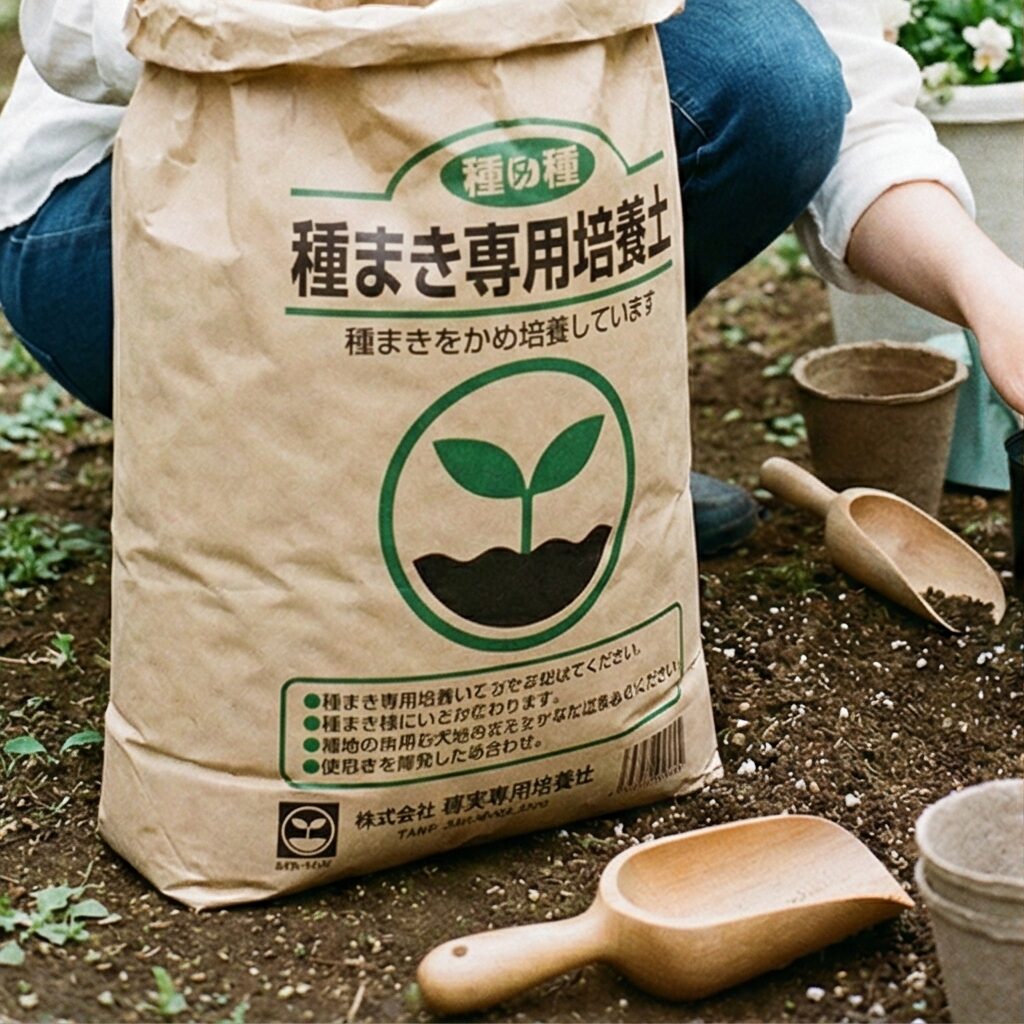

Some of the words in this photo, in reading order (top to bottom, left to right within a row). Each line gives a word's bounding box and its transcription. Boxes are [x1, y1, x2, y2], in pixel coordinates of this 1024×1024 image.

[291, 184, 672, 298] 種まき専用培養土
[344, 289, 656, 356] 種まきをかめ培養しています
[355, 801, 436, 831] 株式会社
